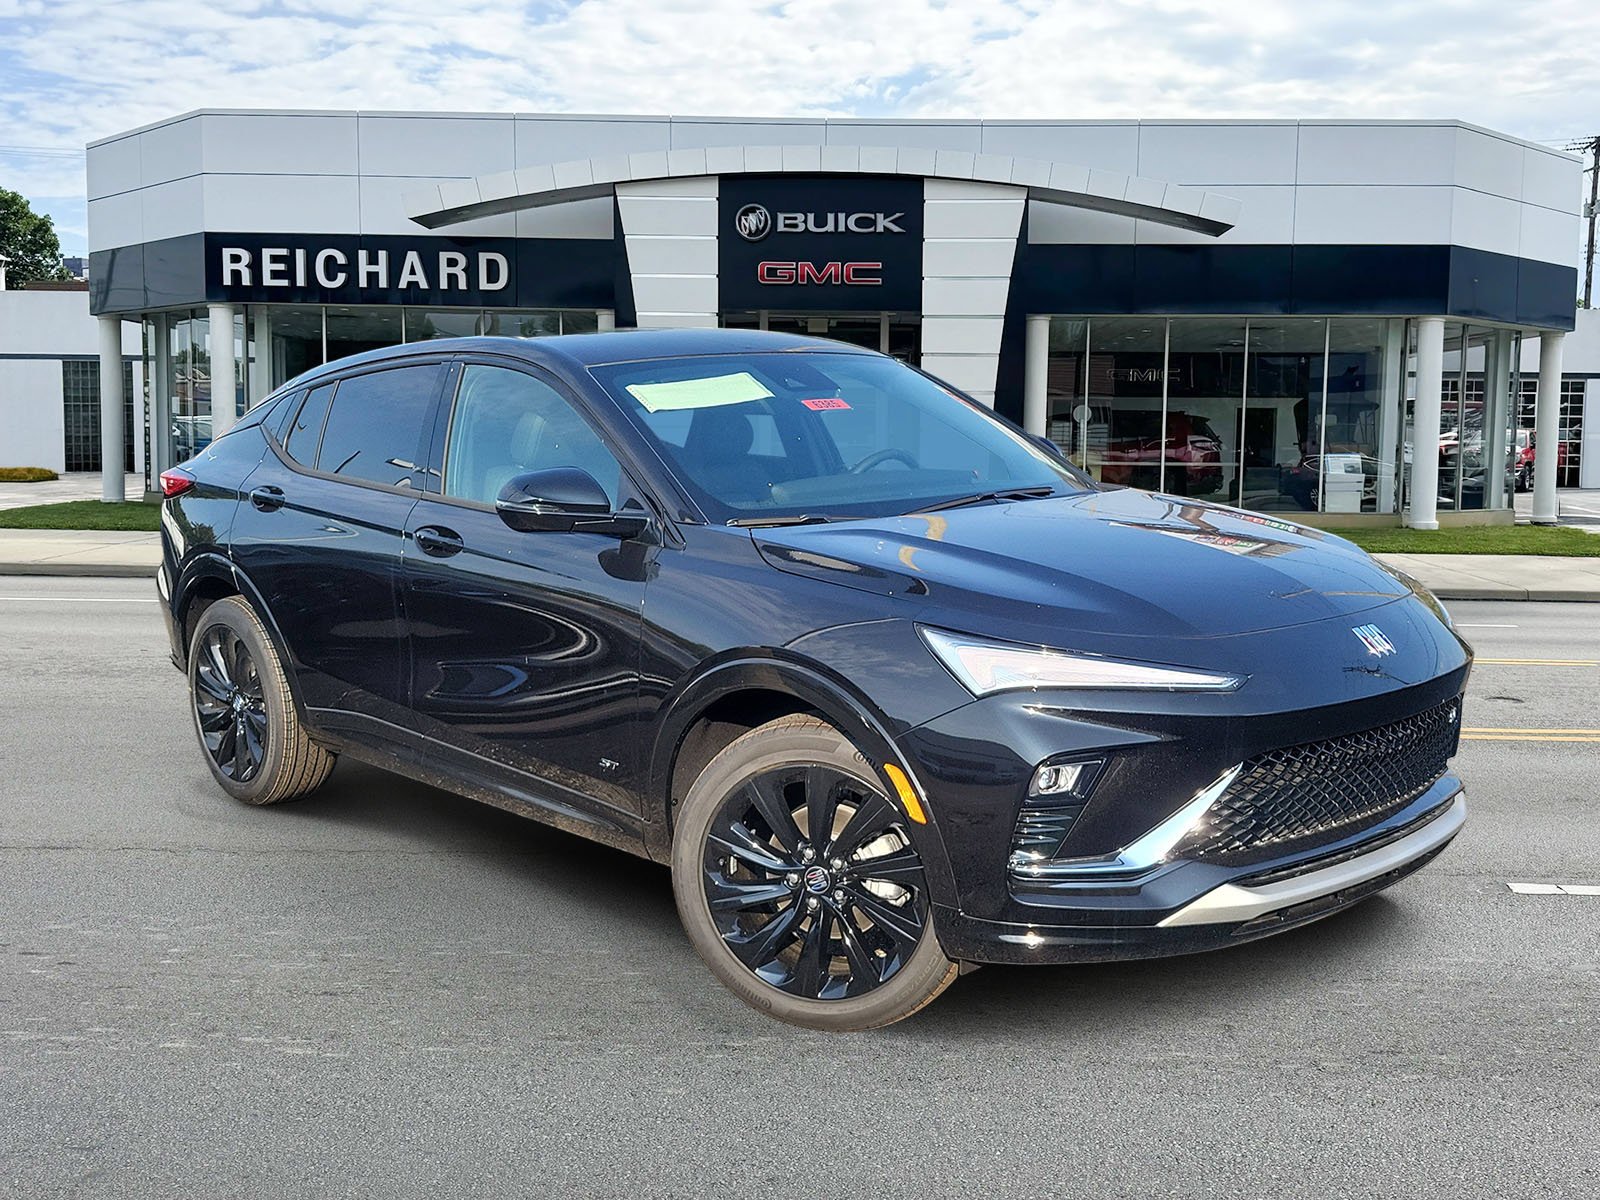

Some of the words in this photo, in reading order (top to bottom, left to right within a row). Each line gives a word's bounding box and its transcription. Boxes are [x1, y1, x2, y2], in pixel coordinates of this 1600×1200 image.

[776, 212, 907, 233] BUICK
[222, 247, 509, 291] REICHARD
[758, 261, 883, 285] GMC
[1106, 368, 1181, 382] GMC
